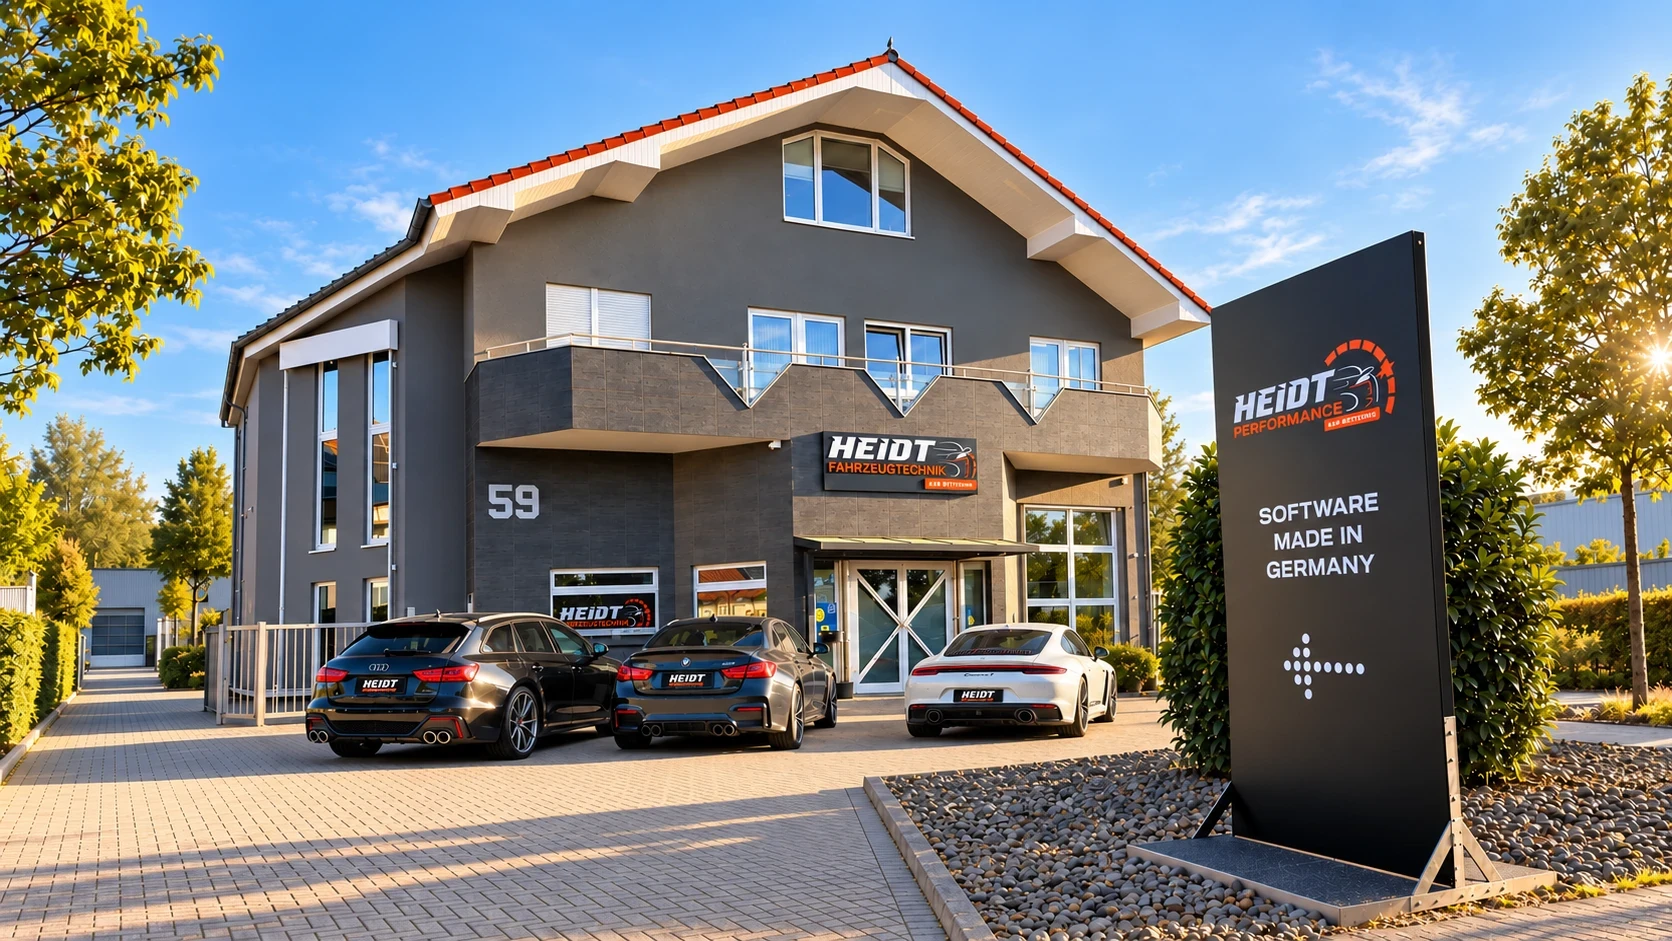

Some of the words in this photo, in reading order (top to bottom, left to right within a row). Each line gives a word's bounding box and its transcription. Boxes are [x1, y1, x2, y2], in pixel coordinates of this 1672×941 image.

[1233, 368, 1336, 424] HEIDT
[1233, 401, 1343, 439] PERFORMANCE
[828, 435, 936, 462] HEIDT
[828, 461, 947, 476] FAHRZEUGTECHNIK
[488, 484, 540, 519] 59
[1259, 492, 1379, 525] SOFTWARE
[1273, 527, 1334, 551] MADE
[1340, 524, 1363, 545] IN
[1266, 553, 1375, 579] GERMANY
[560, 605, 624, 621] HEIDT
[362, 679, 398, 688] HEIDT
[669, 674, 706, 683] HEIDT
[961, 690, 995, 698] HEIDT
